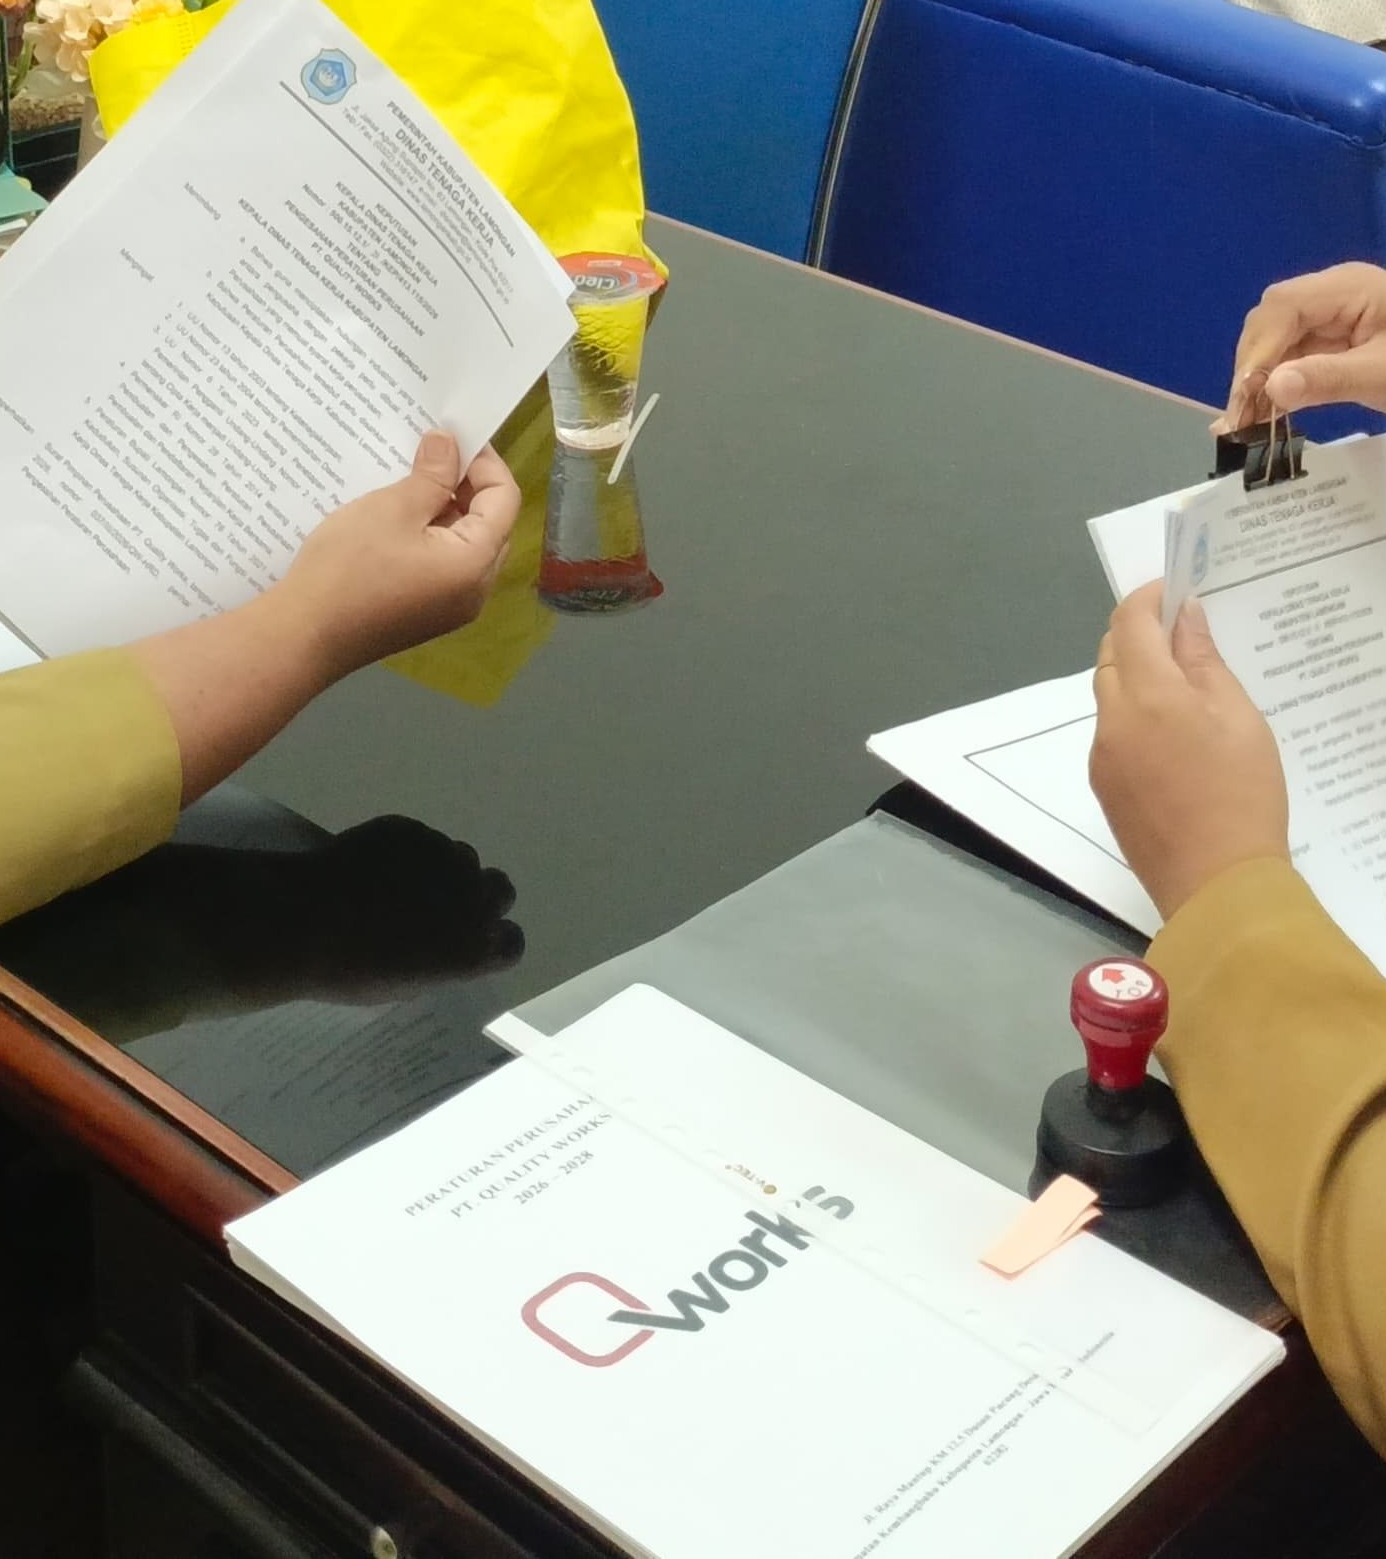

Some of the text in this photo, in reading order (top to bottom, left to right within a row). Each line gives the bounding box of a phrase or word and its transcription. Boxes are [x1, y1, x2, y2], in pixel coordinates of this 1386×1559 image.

[387, 101, 514, 256] PEMERINTAH KABUPATEN LAMONGAN
[395, 129, 493, 247] DINAS TENAGA KERJA
[336, 181, 437, 286] KEPALA DINAS TENAGA KERJA
[338, 201, 420, 283] KABUPATEN LAMONGAN
[348, 242, 380, 276] TENTANG
[375, 203, 417, 246] KEPUTUSAN
[238, 198, 427, 381] KEPALA DINAS TENAGA KERJA KABUPATEN LAMONGAN
[285, 200, 423, 335] PENGESAHAN PERATURAN PERUSAHAAN
[323, 254, 354, 282] QUALITY
[355, 283, 381, 310] WORKS
[574, 274, 615, 290] Cleo
[1116, 980, 1148, 999] TOP
[404, 1095, 595, 1217] PERATURAN PERUSAHA
[479, 1150, 551, 1200] QUALITY
[551, 1111, 613, 1152] WORKS
[514, 1149, 595, 1205] 2026 2028
